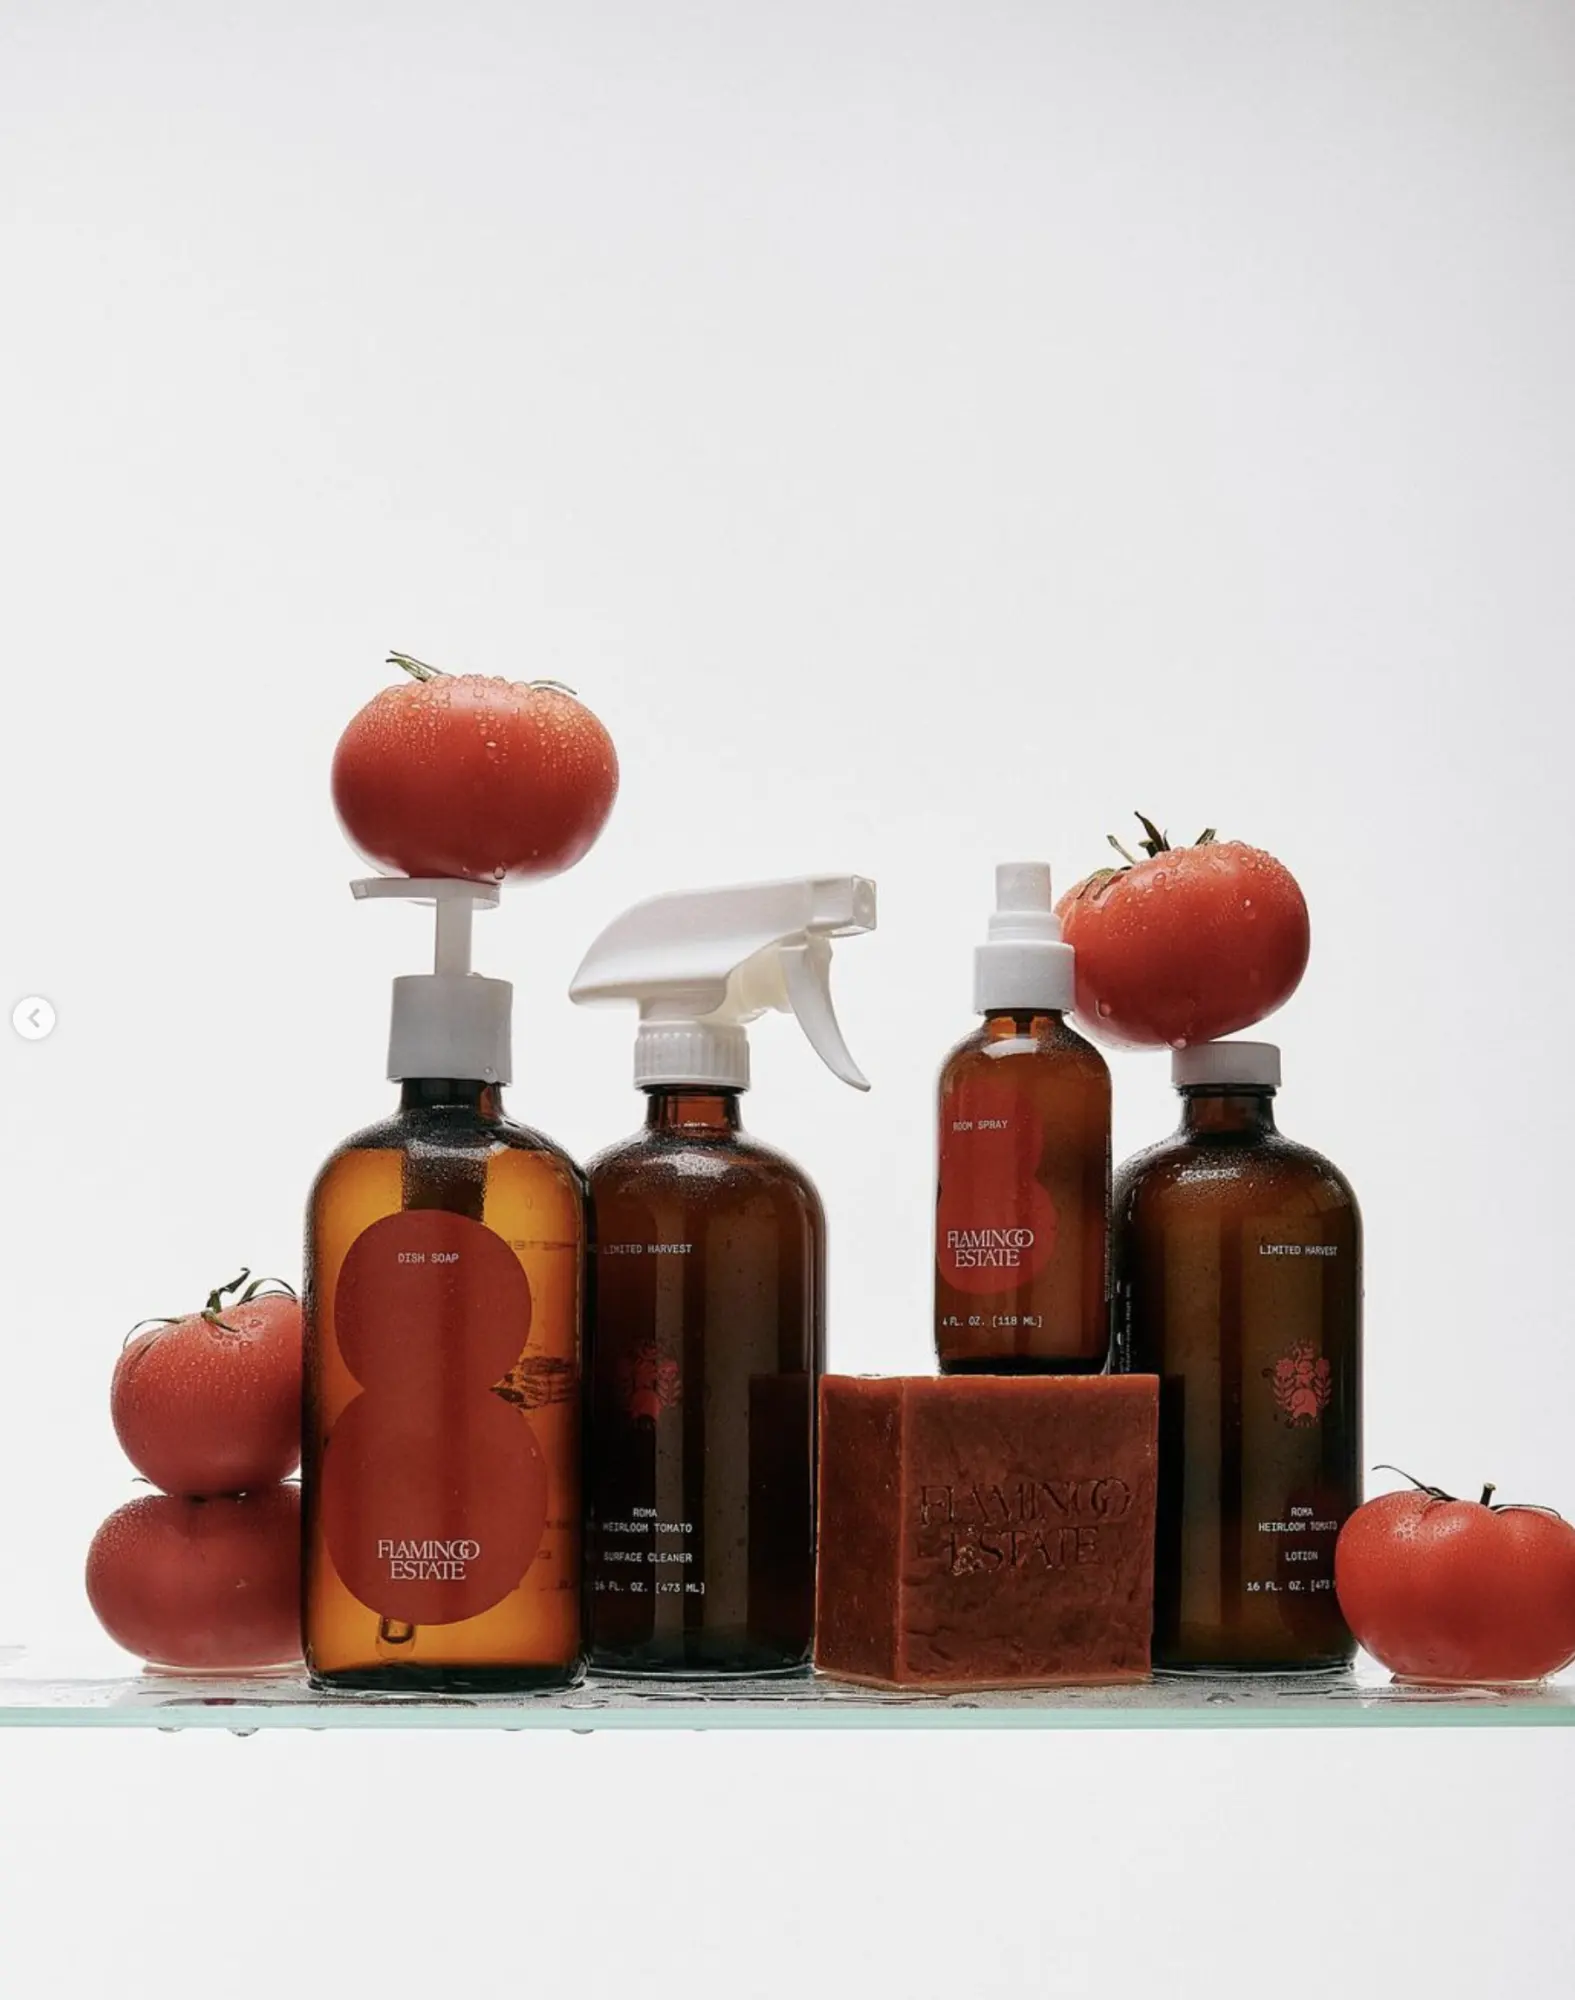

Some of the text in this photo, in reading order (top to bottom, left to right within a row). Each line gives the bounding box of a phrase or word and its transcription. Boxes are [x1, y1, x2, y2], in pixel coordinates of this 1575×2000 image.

[978, 1119, 1008, 1130] SPRAY
[947, 1228, 1034, 1249] FLAMINGO
[603, 1244, 643, 1255] LIMITED
[647, 1243, 693, 1254] HARVEST
[1260, 1244, 1338, 1256] LIMITED HARVEST
[397, 1252, 459, 1264] DISH SOAP
[955, 1248, 1021, 1267] ESTATE
[949, 1316, 964, 1326] FL.
[968, 1315, 985, 1326] OZ.
[992, 1315, 1018, 1328] [118
[1023, 1315, 1042, 1328] ML]
[632, 1507, 658, 1518] ROMA
[1290, 1507, 1314, 1517] ROMA
[603, 1522, 649, 1533] HEIRLOOM
[654, 1523, 693, 1533] TOMATO
[1258, 1521, 1338, 1532] HEIRLOOM TOMATO
[377, 1539, 480, 1560] FLAMINGO
[603, 1551, 693, 1563] SURFACE CLEANER
[1284, 1551, 1318, 1561] LOTION
[391, 1560, 467, 1580] ESTATE
[608, 1580, 625, 1592] FL.
[630, 1581, 648, 1592] OZ.
[655, 1582, 681, 1594] [473
[685, 1582, 705, 1594] ML]
[1246, 1581, 1260, 1592] 16
[1265, 1581, 1282, 1591] FL.
[1288, 1580, 1305, 1591] OZ.
